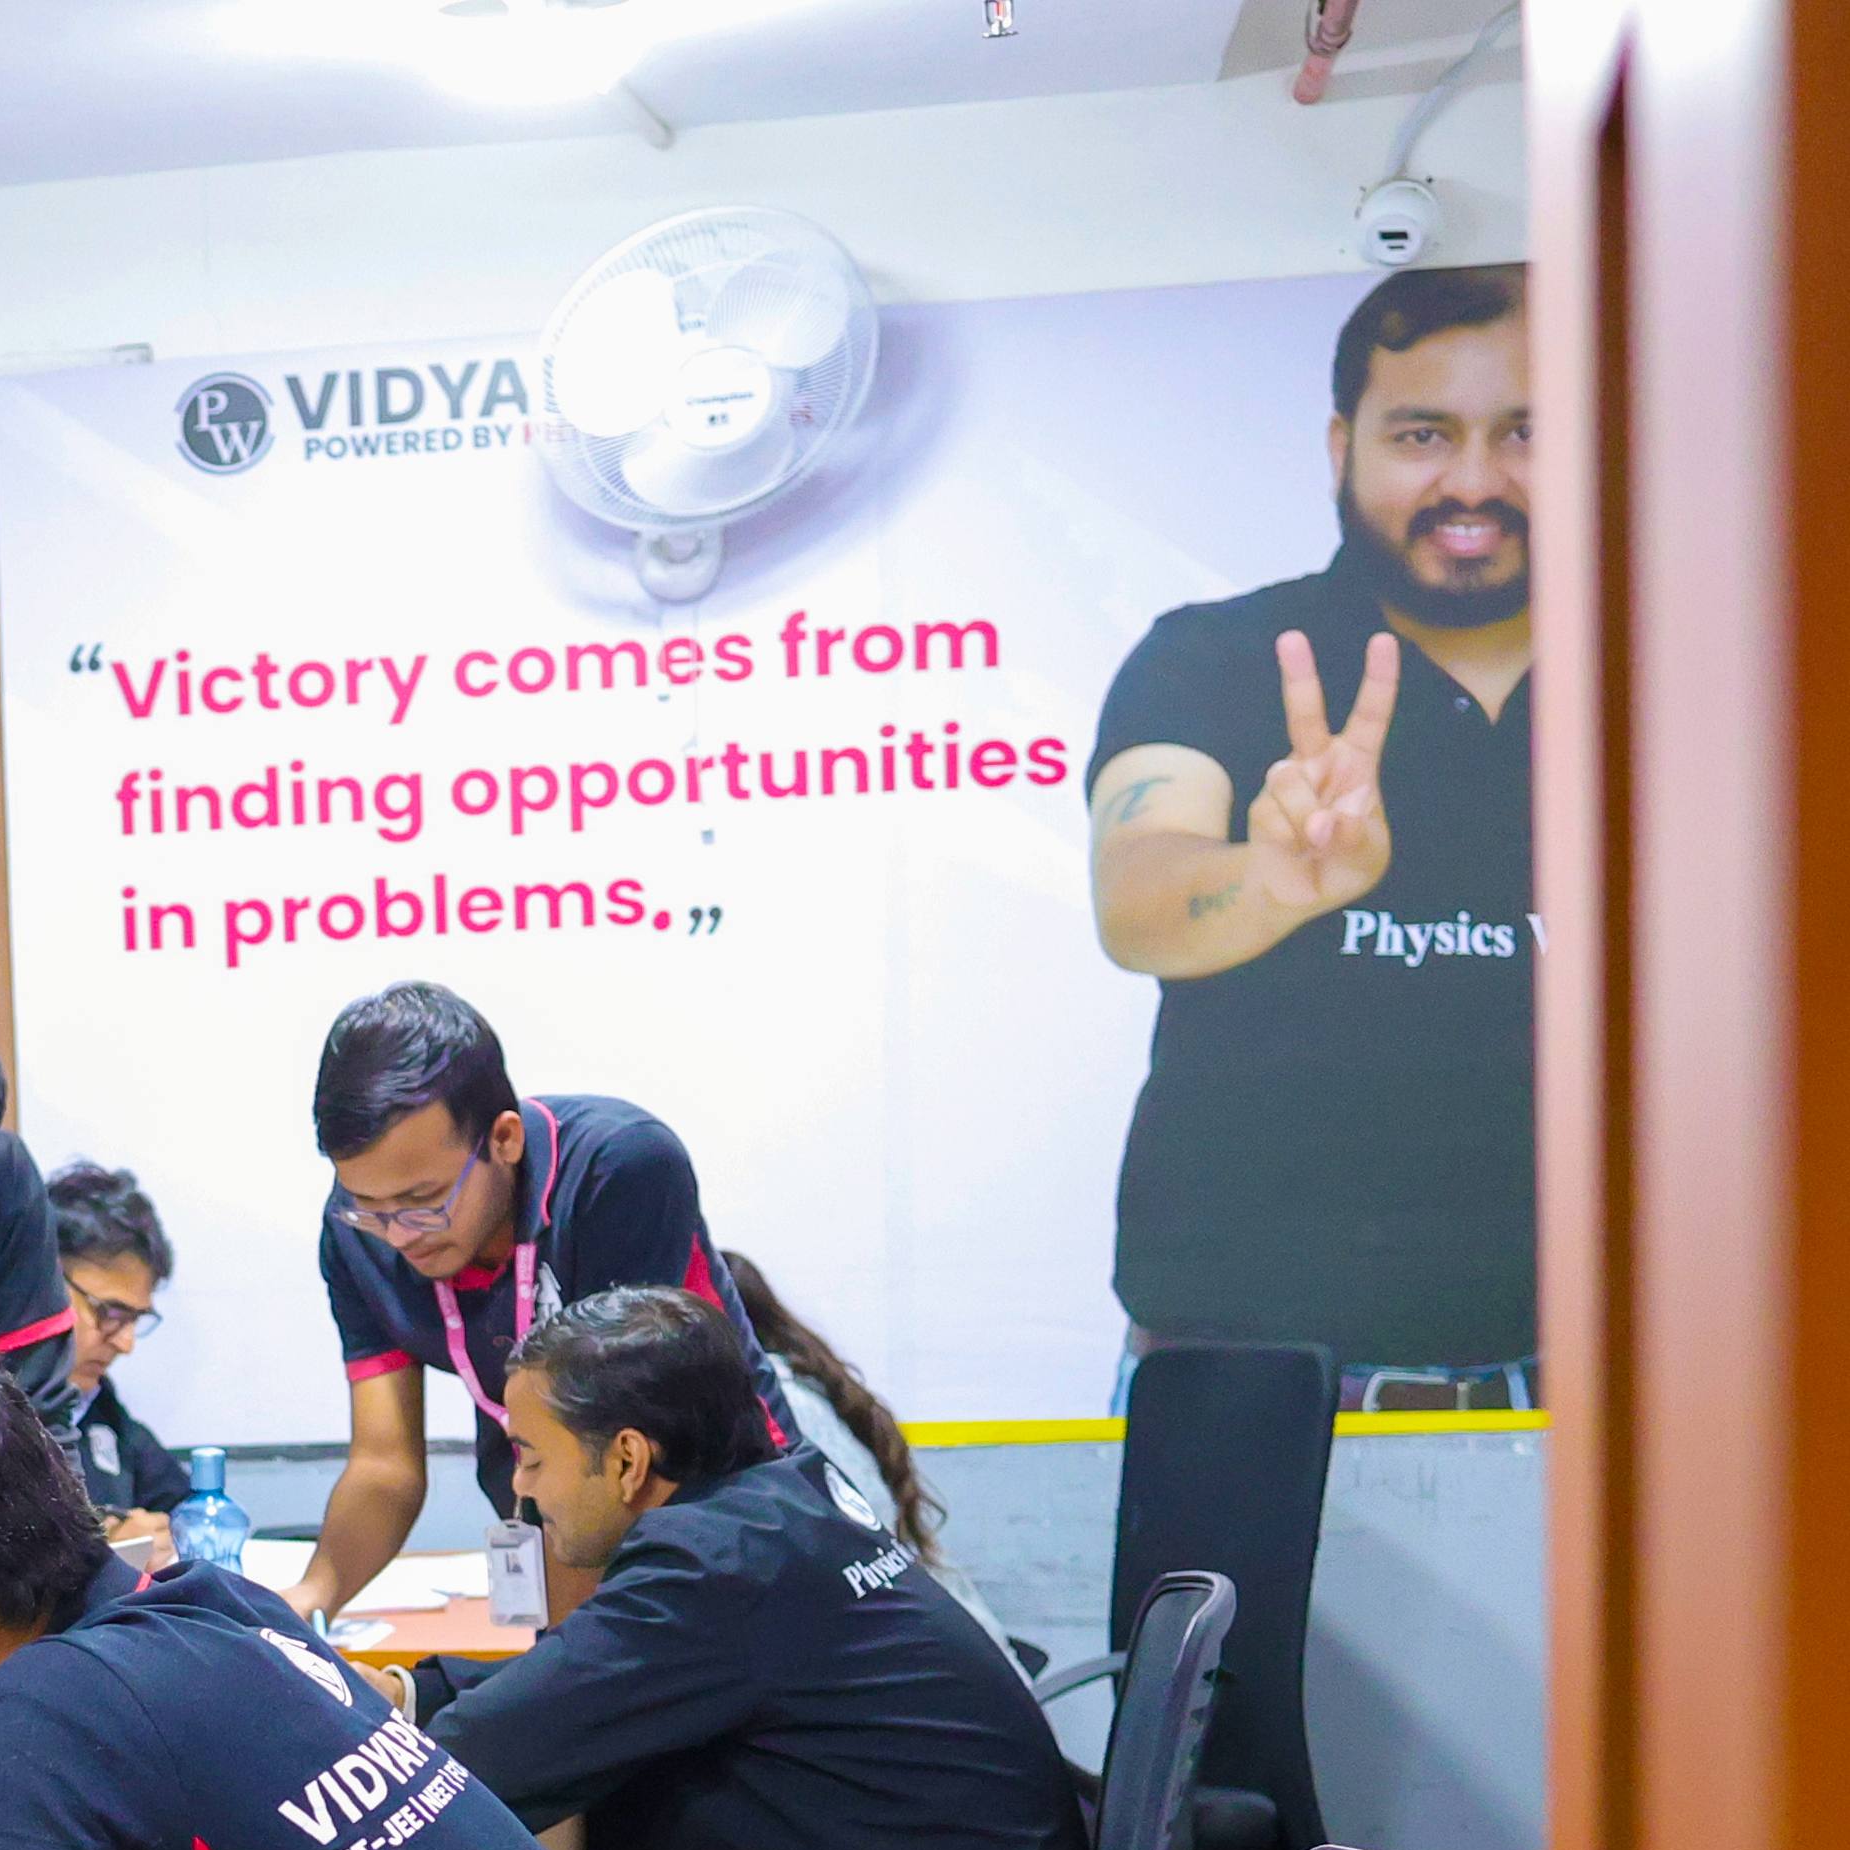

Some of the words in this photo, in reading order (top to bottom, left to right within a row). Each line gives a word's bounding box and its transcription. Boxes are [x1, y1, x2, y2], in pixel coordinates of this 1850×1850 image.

[285, 358, 530, 431] VIDYA
[304, 426, 463, 462] POWERED
[473, 424, 512, 450] BY
[453, 633, 755, 698] comes
[780, 610, 1000, 679] from
[114, 759, 425, 845] finding
[450, 720, 1070, 838] opportunities
[120, 886, 197, 954] in
[1340, 909, 1517, 968] Physics
